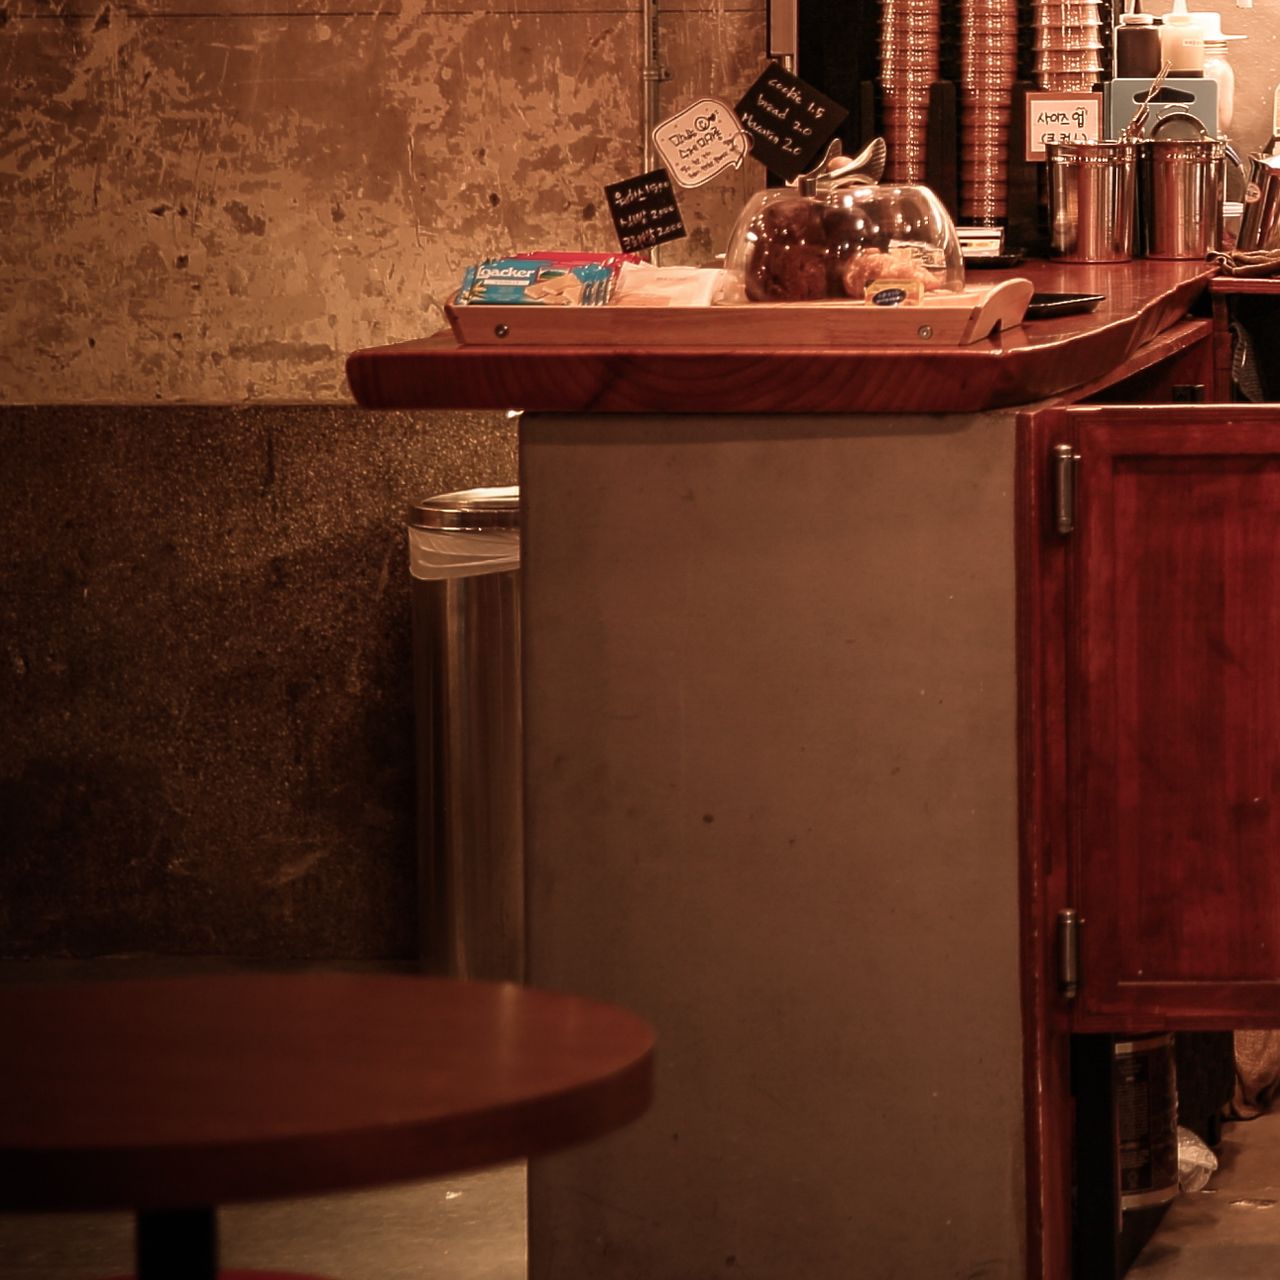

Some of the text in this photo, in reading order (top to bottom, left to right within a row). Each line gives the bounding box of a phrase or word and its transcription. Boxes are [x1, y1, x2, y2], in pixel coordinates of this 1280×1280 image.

[768, 79, 801, 105] cookie
[758, 94, 814, 137] bread 2.0
[1037, 111, 1071, 126] 사이즈
